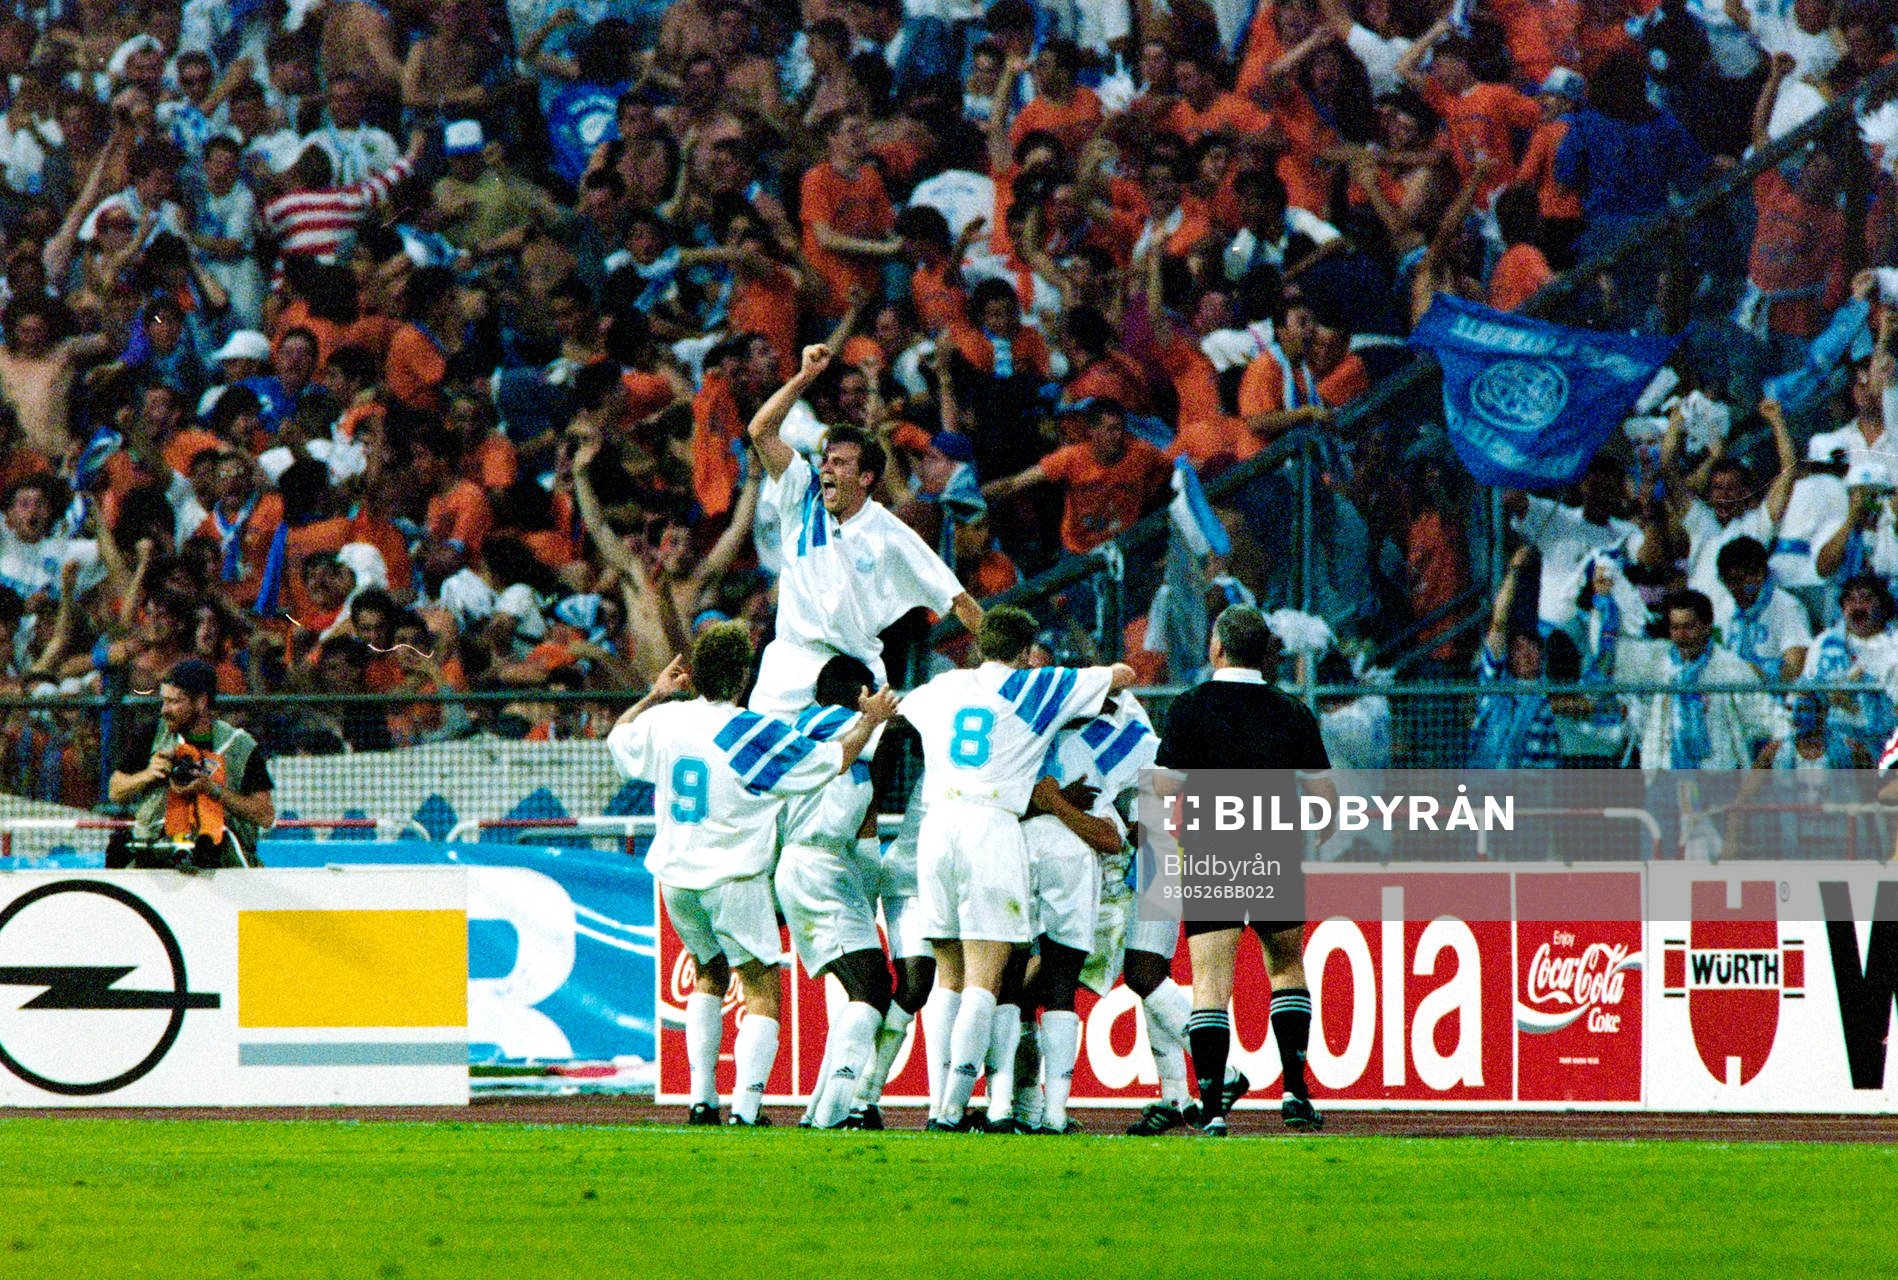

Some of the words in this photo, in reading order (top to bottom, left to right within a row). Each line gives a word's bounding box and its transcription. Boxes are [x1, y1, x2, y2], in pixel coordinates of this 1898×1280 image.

[949, 705, 997, 769] 8
[670, 755, 710, 824] 9
[1553, 930, 1575, 947] Enjoy
[1527, 942, 1628, 1005] Coca-Cola
[1691, 954, 1779, 984] WÜRTH
[1587, 1007, 1621, 1033] Coke
